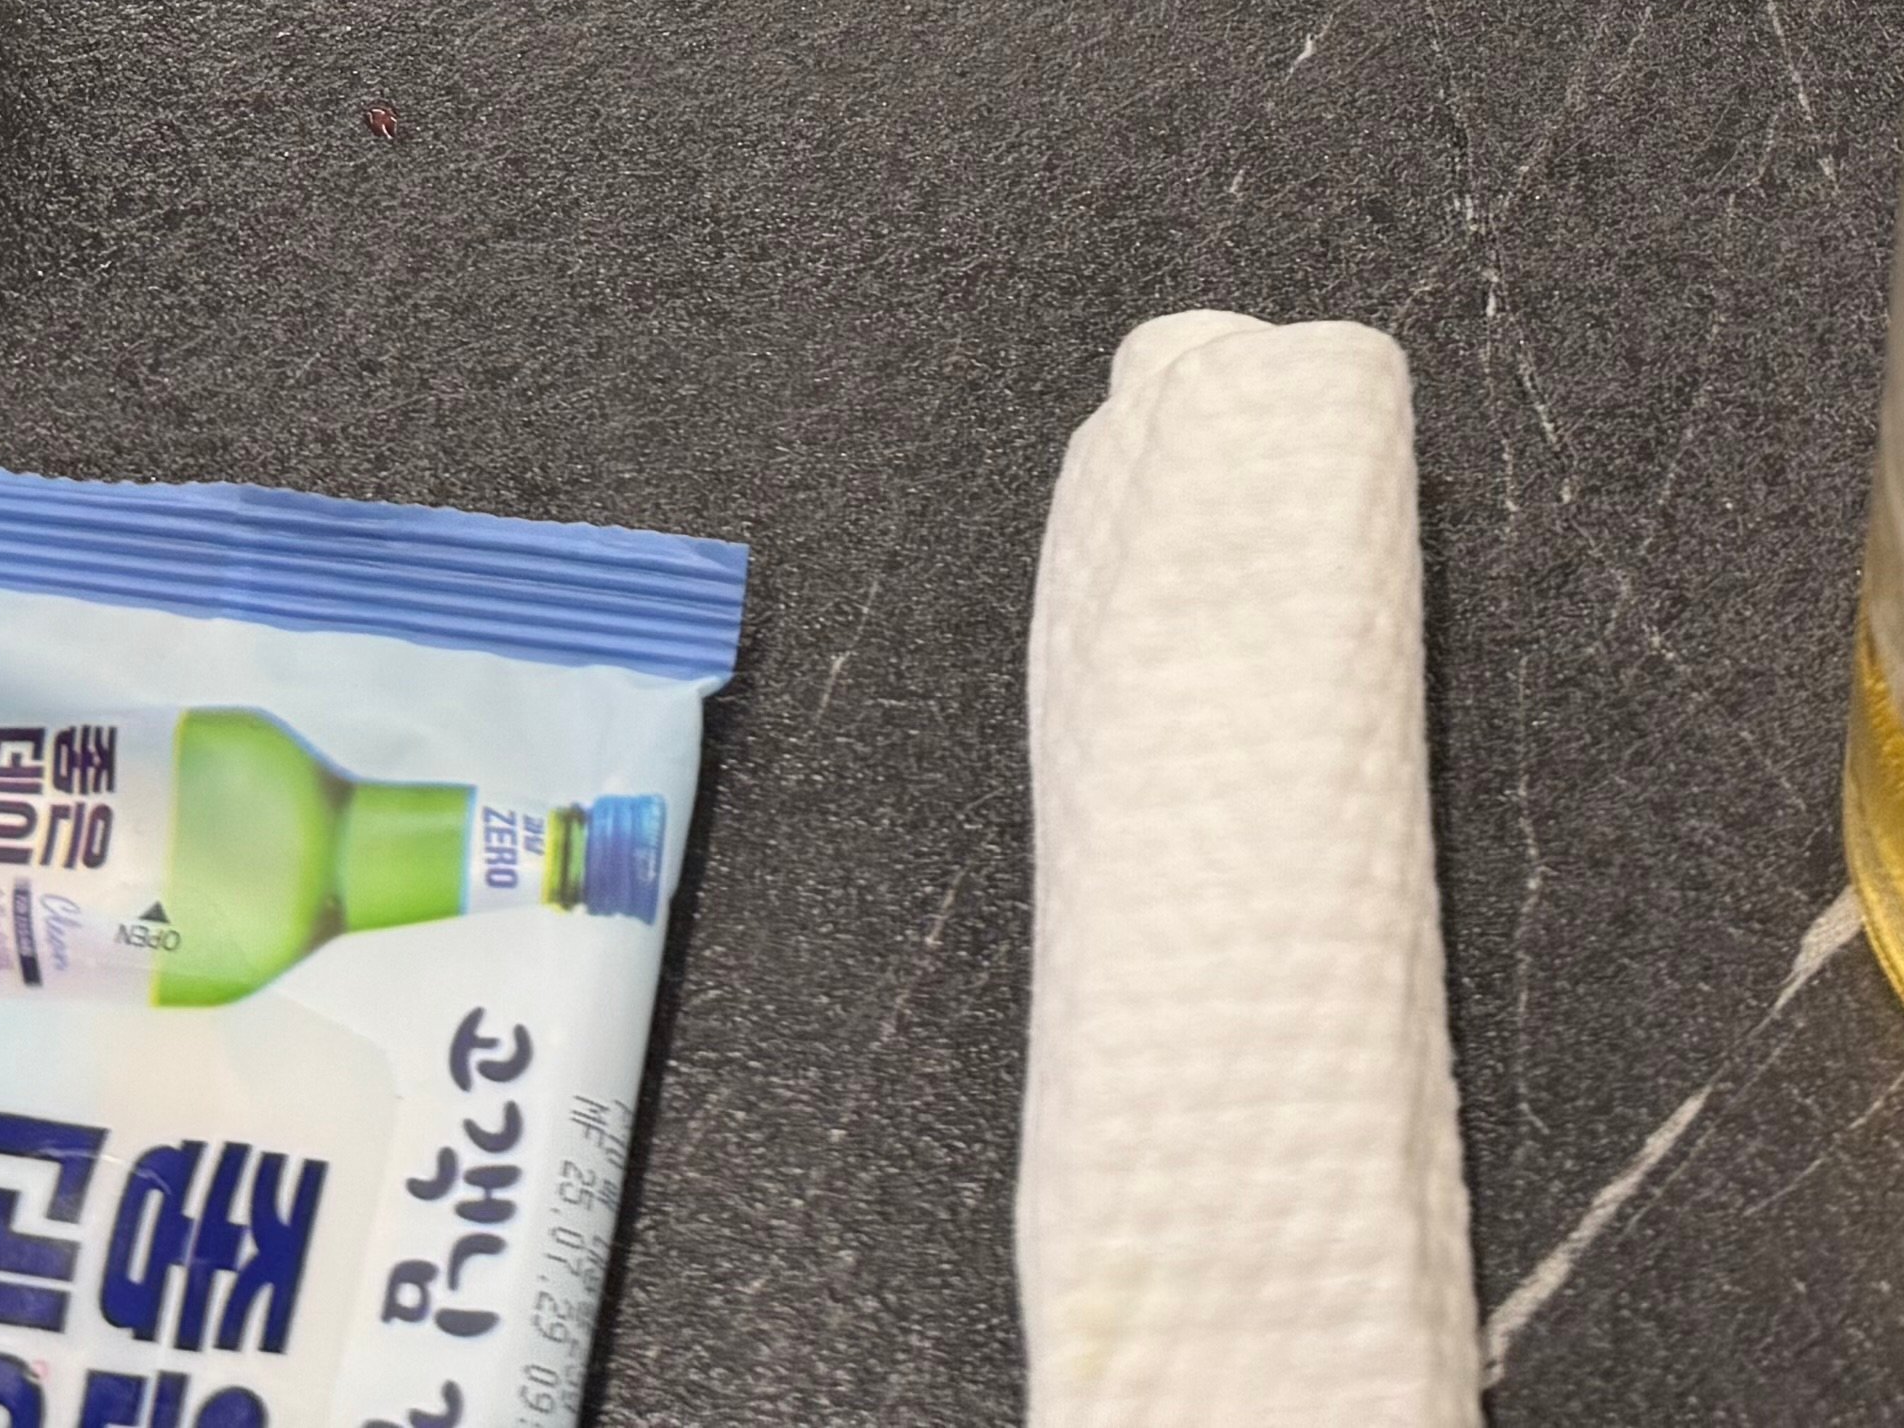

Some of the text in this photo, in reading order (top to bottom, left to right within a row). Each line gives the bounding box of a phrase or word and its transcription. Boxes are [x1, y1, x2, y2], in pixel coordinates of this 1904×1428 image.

[39, 724, 118, 869] 좋은
[482, 805, 519, 889] ZERO
[114, 923, 182, 952] OPEN
[381, 1005, 535, 1338] 고객님
[531, 1159, 597, 1343] 25.07.29
[78, 1140, 330, 1428] 좋
